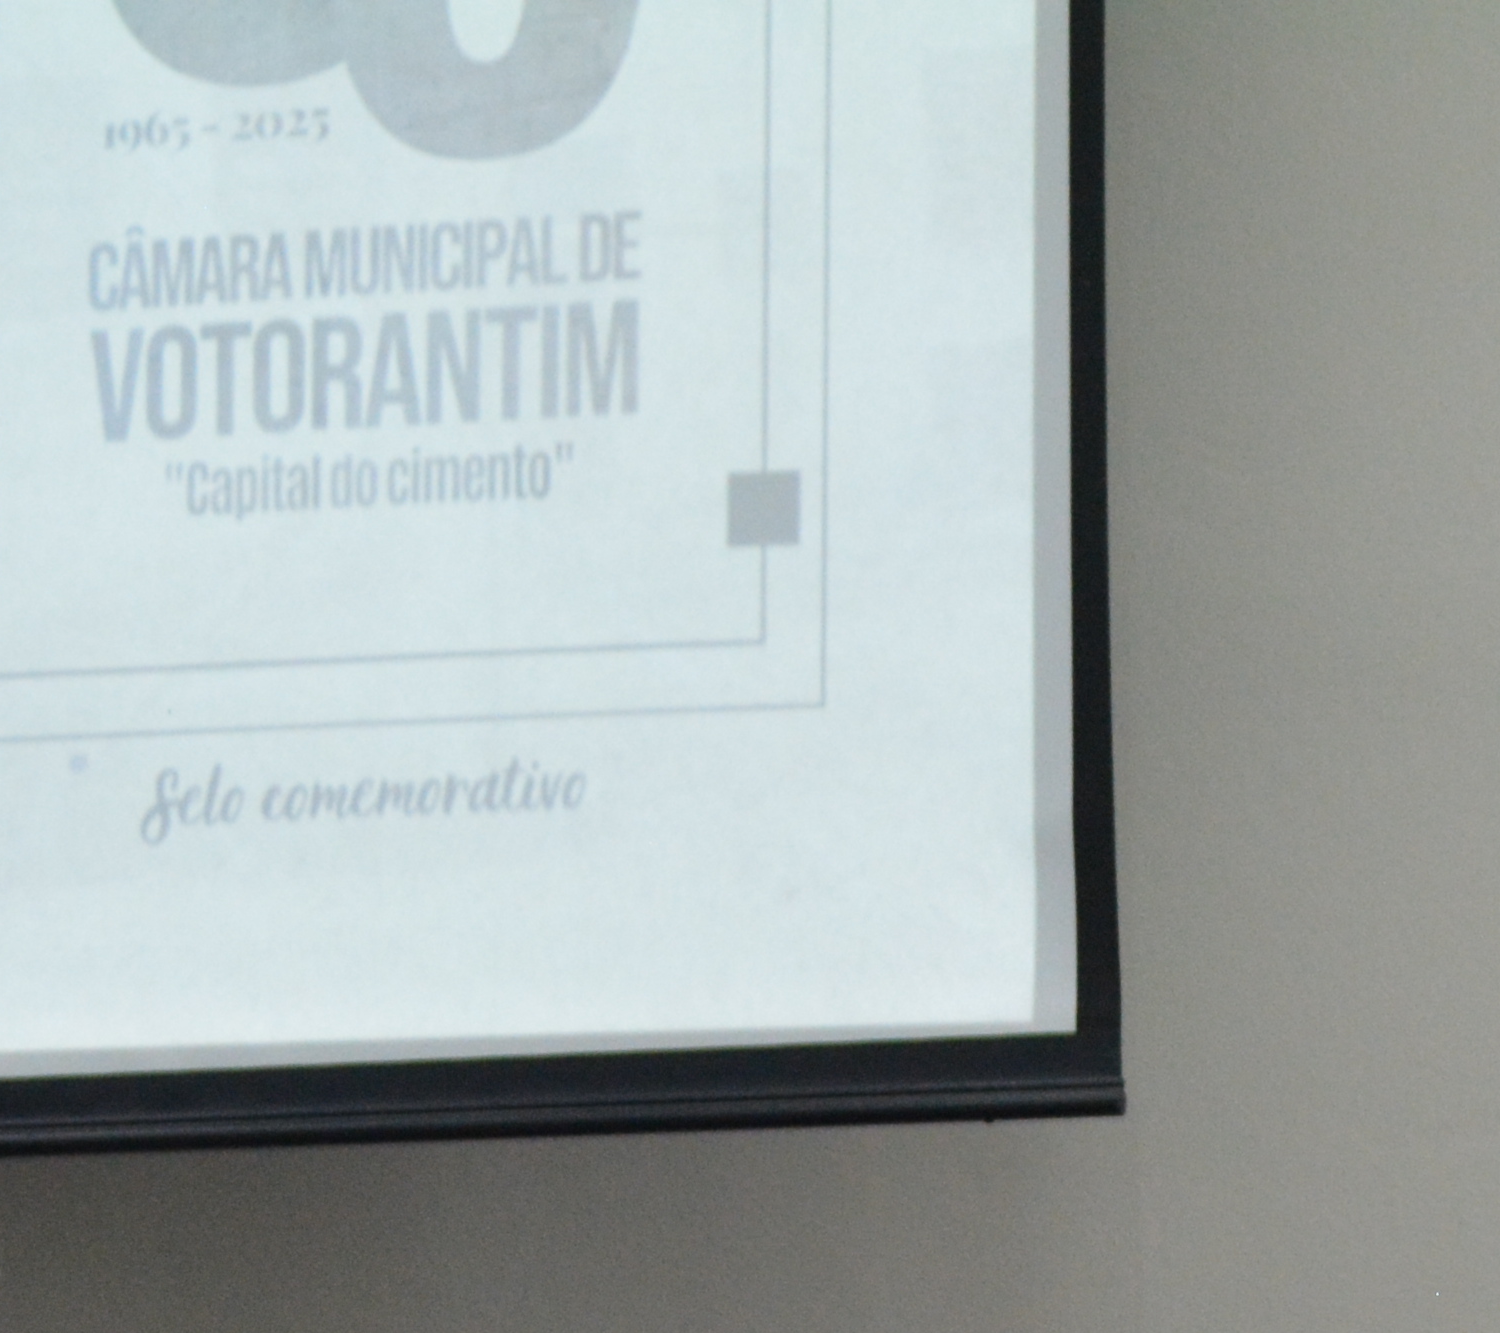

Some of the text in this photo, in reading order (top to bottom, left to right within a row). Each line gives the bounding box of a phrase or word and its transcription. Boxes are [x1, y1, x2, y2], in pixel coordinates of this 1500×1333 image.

[104, 110, 191, 152] 1965
[231, 105, 331, 141] 2025
[87, 210, 642, 311] CÂMARA MUNICIPAL DE
[90, 299, 640, 443] VOTORANTIM
[165, 442, 574, 522] "Capital do cimento"
[139, 755, 588, 846] Selo comemorativo
